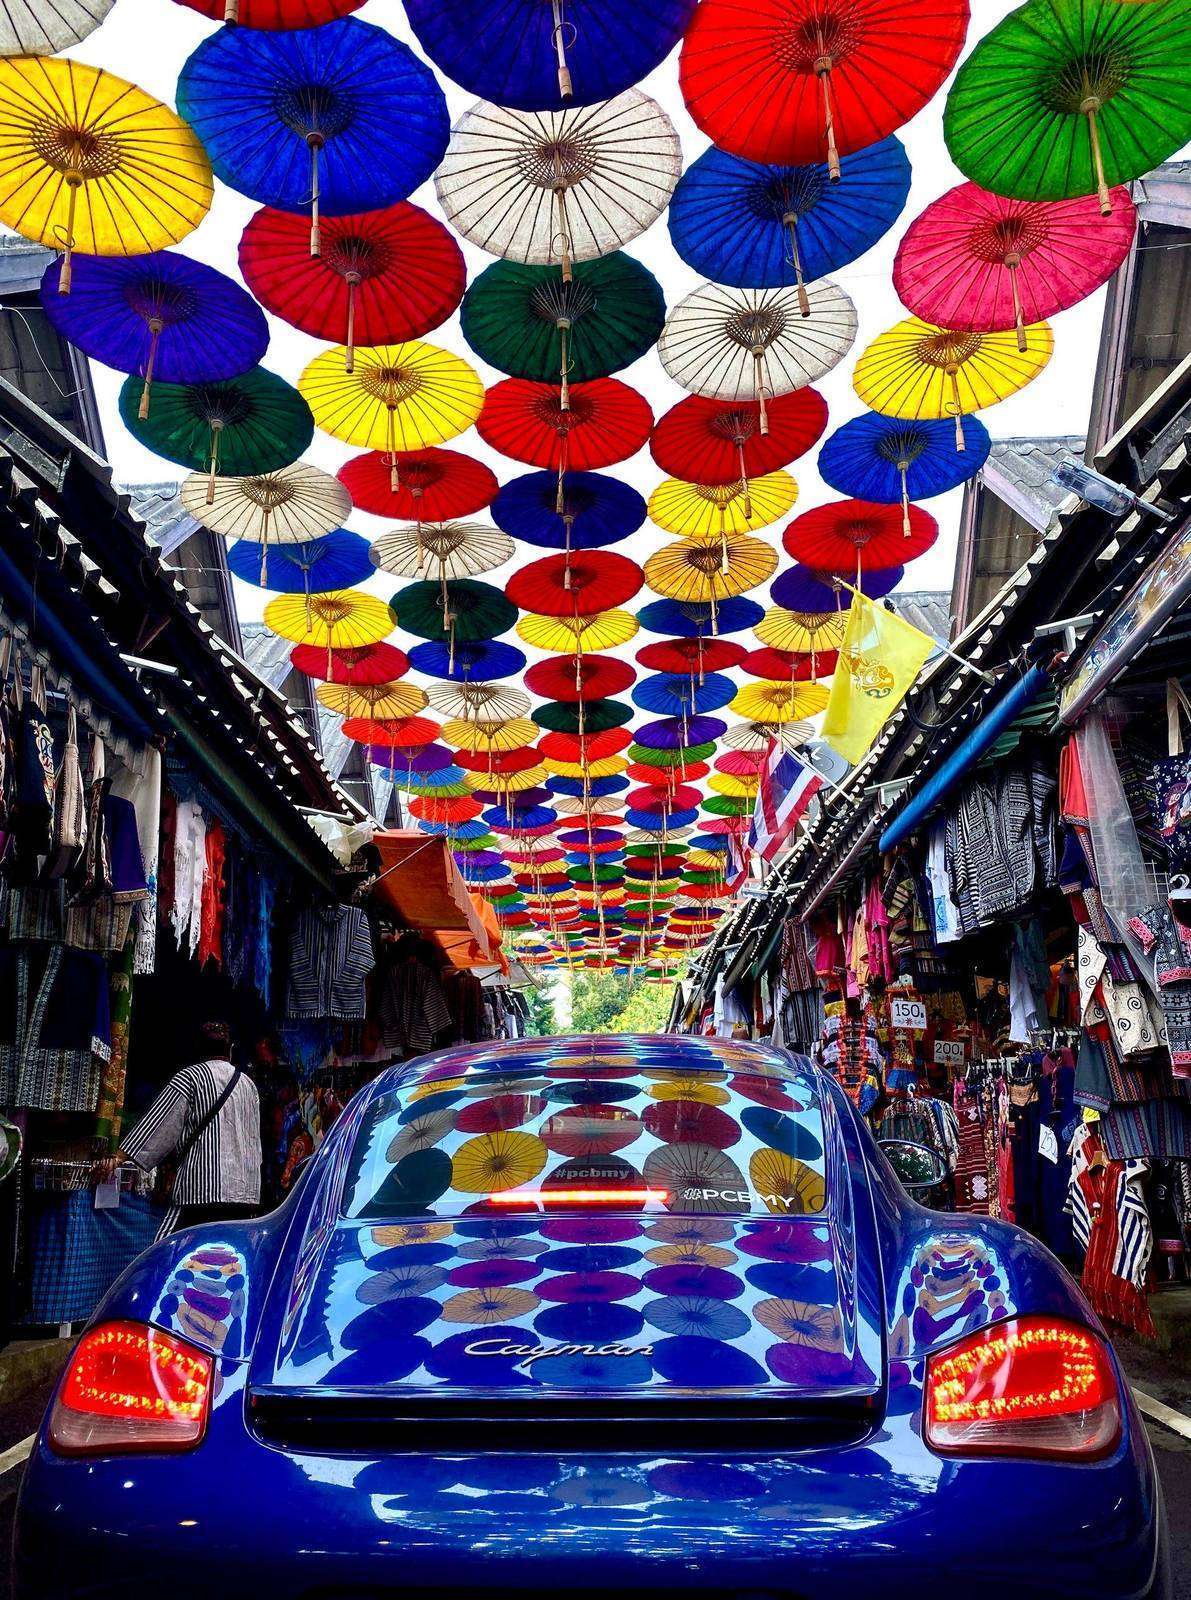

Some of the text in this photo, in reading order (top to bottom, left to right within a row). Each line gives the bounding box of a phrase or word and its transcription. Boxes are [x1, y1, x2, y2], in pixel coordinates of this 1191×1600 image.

[555, 1168, 629, 1180] #pcbmy
[683, 1188, 795, 1208] #PCBMY
[464, 1338, 654, 1368] Cayman
